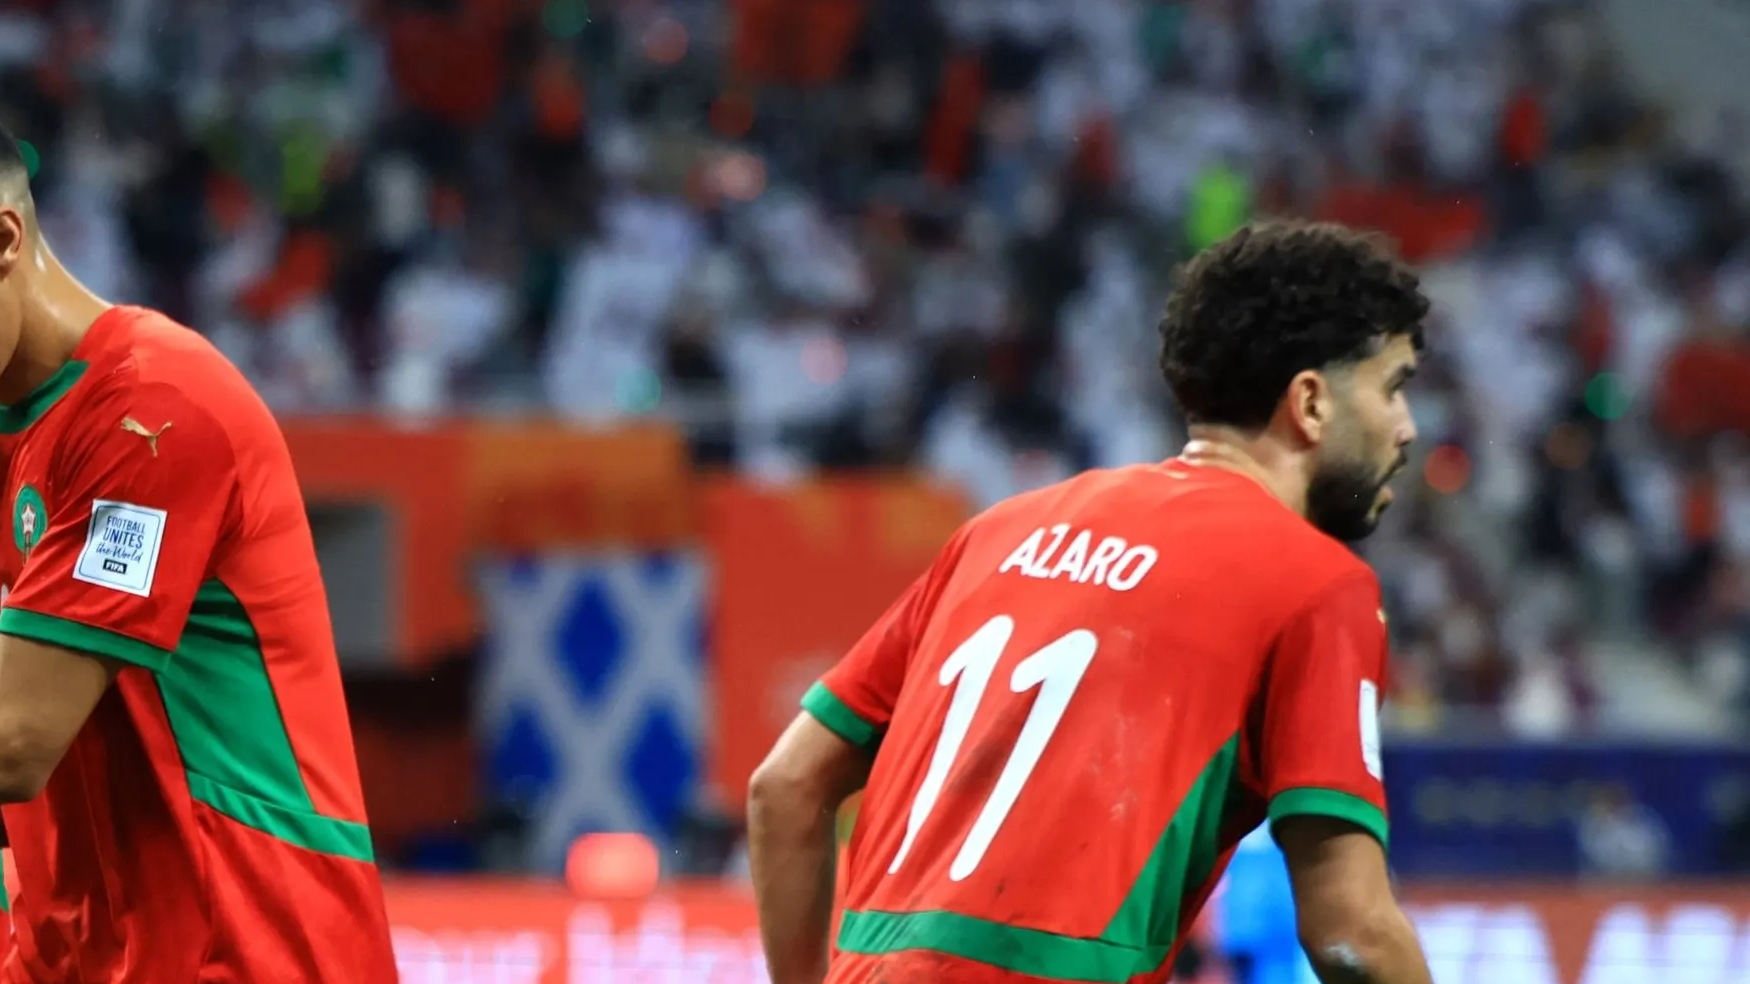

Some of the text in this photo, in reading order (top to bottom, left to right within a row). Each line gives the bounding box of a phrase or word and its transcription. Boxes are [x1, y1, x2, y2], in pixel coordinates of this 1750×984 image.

[106, 515, 146, 534] FOOTBALL
[102, 527, 144, 550] UNITES
[95, 541, 144, 563] the World
[998, 522, 1160, 592] AZARO
[105, 561, 125, 573] FIFA
[887, 613, 1100, 883] 11
